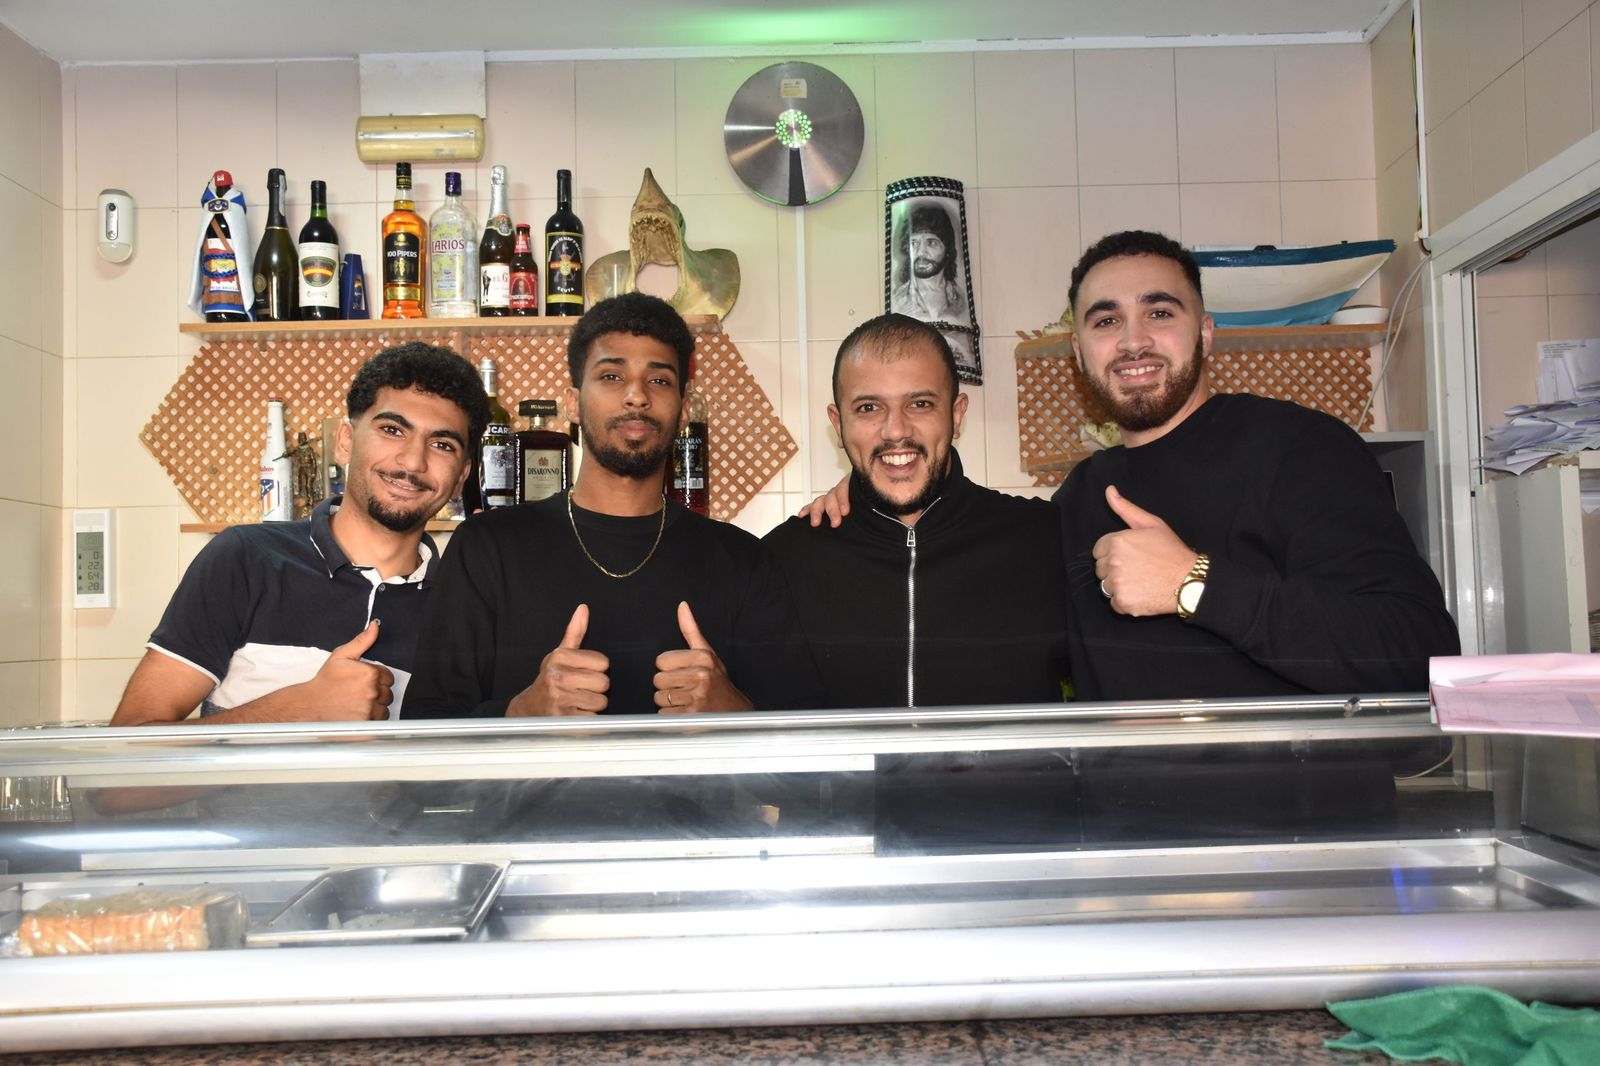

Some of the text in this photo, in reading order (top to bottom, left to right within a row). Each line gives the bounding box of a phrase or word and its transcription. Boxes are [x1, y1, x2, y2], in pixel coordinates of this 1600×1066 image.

[431, 239, 465, 253] LARIOS
[387, 249, 418, 258] 100 PIPERS
[527, 467, 560, 475] DISARONNO
[87, 582, 100, 591] 28
